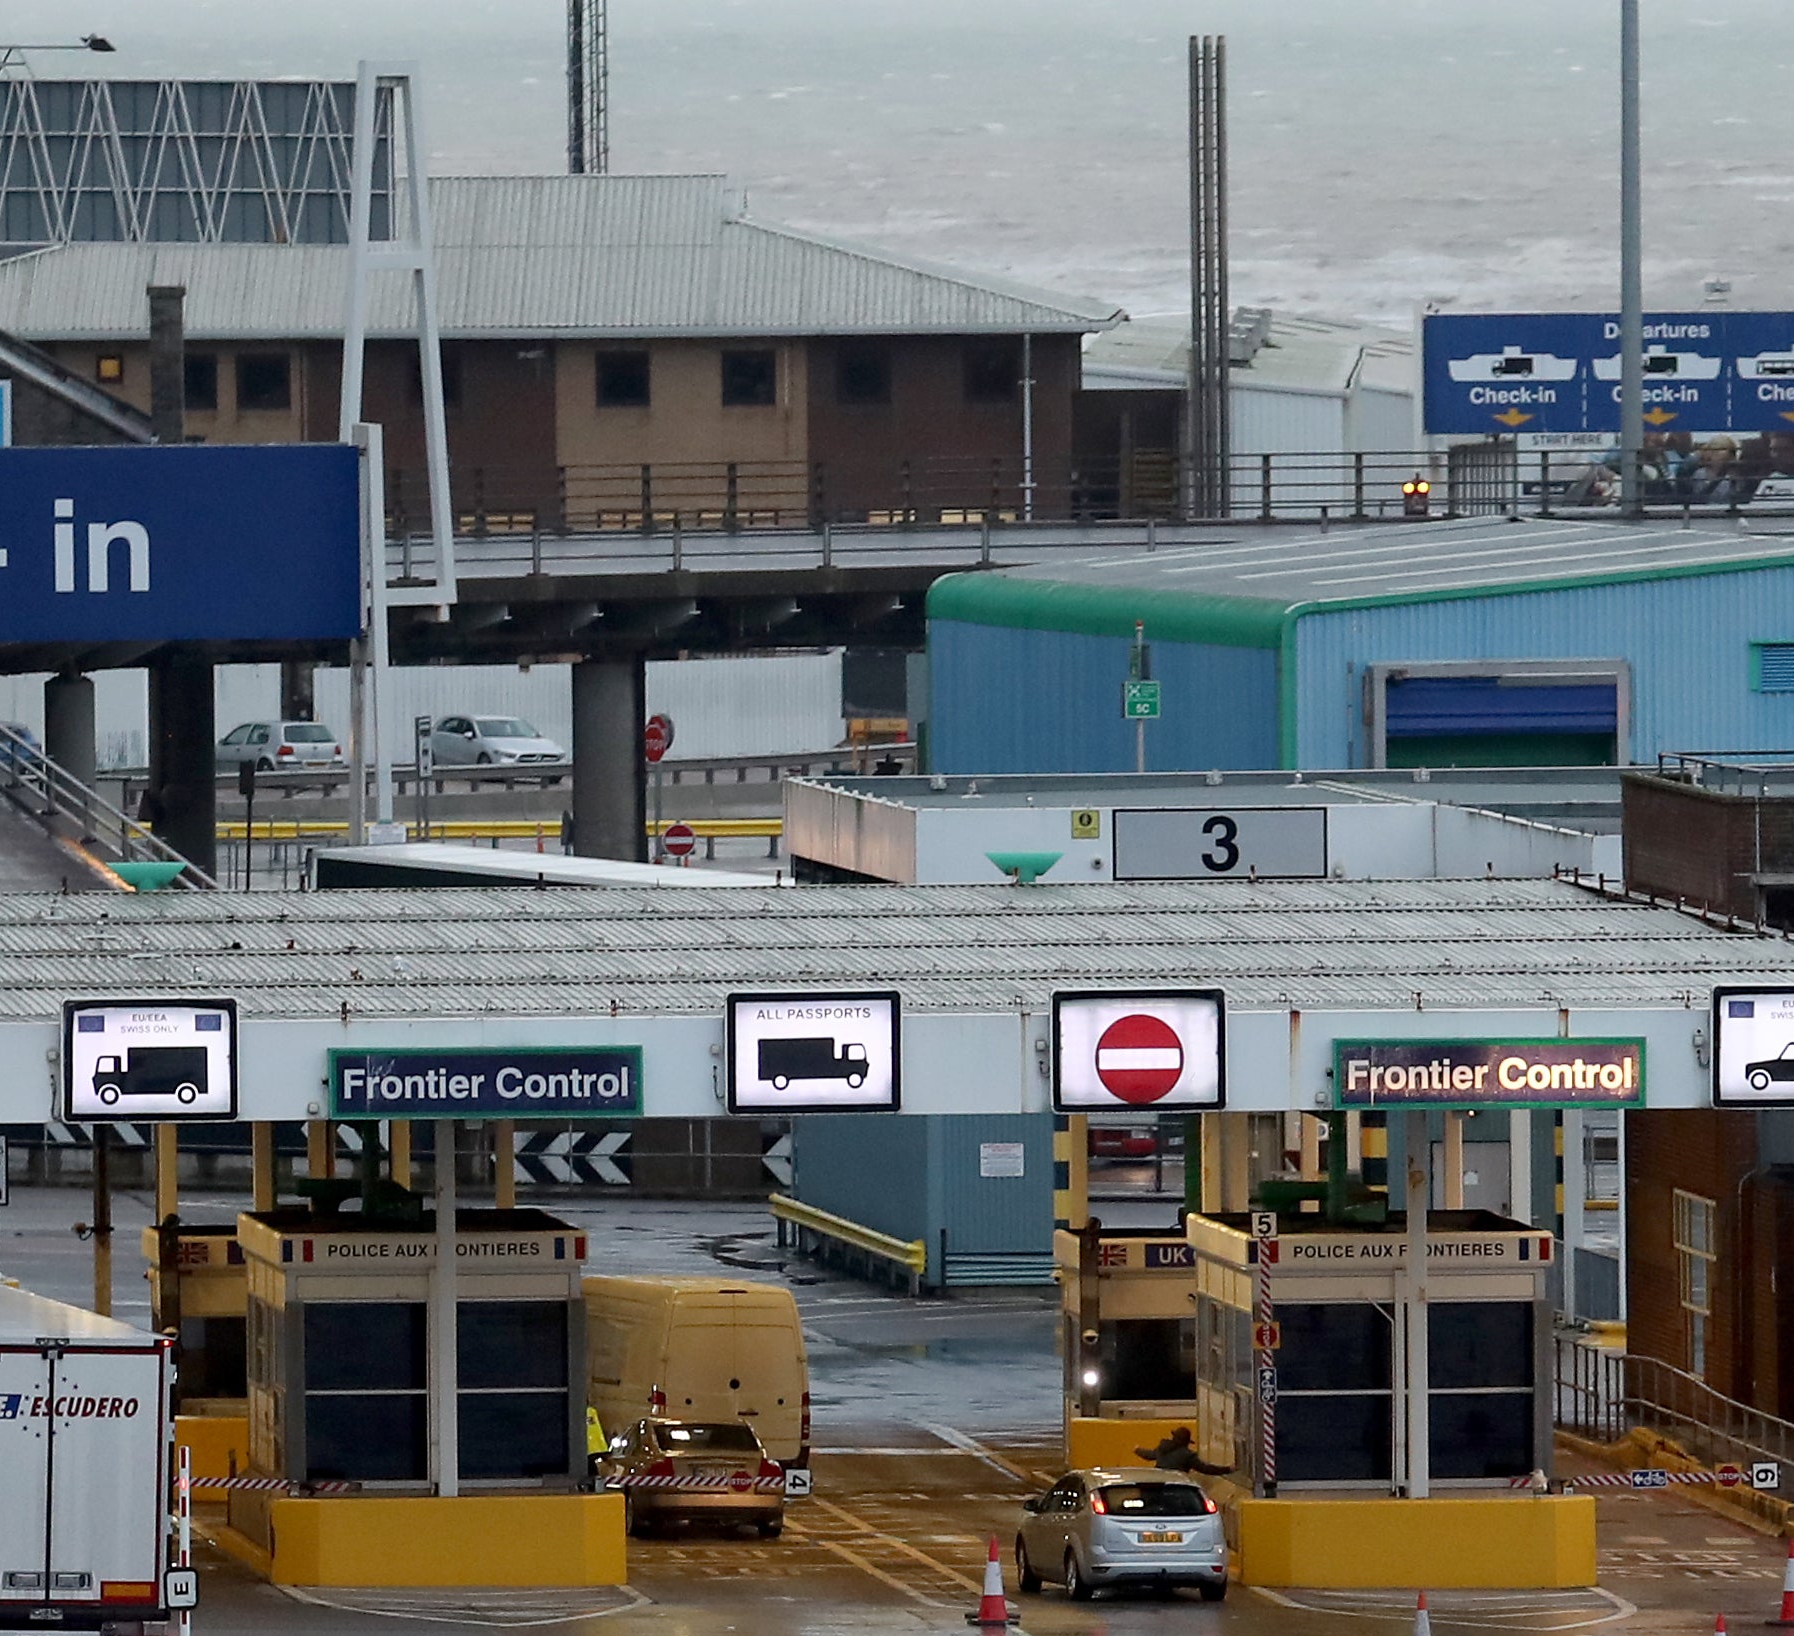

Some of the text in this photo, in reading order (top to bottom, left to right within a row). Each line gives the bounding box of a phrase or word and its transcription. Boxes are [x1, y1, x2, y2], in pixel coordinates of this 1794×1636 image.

[1604, 321, 1711, 339] Dartures
[1469, 386, 1556, 404] Check-in
[1611, 385, 1700, 403] Ceck-in
[54, 498, 151, 593] in
[1201, 815, 1240, 872] 3
[756, 1006, 872, 1020] ALL PASSPORTS
[120, 1025, 180, 1034] SWISS ONLY
[1347, 1056, 1634, 1091] Frontier Control
[342, 1066, 630, 1100] Frontier Control
[1257, 1214, 1272, 1236] 5
[327, 1242, 541, 1258] POLICE AUX ONTIERES
[1158, 1246, 1186, 1265] UK
[1293, 1242, 1505, 1260] POLICE AUX FONTIERES
[29, 1396, 139, 1418] ESCUDERO
[788, 1474, 807, 1490] 4
[1717, 1472, 1740, 1481] STOP
[174, 1581, 189, 1595] E
